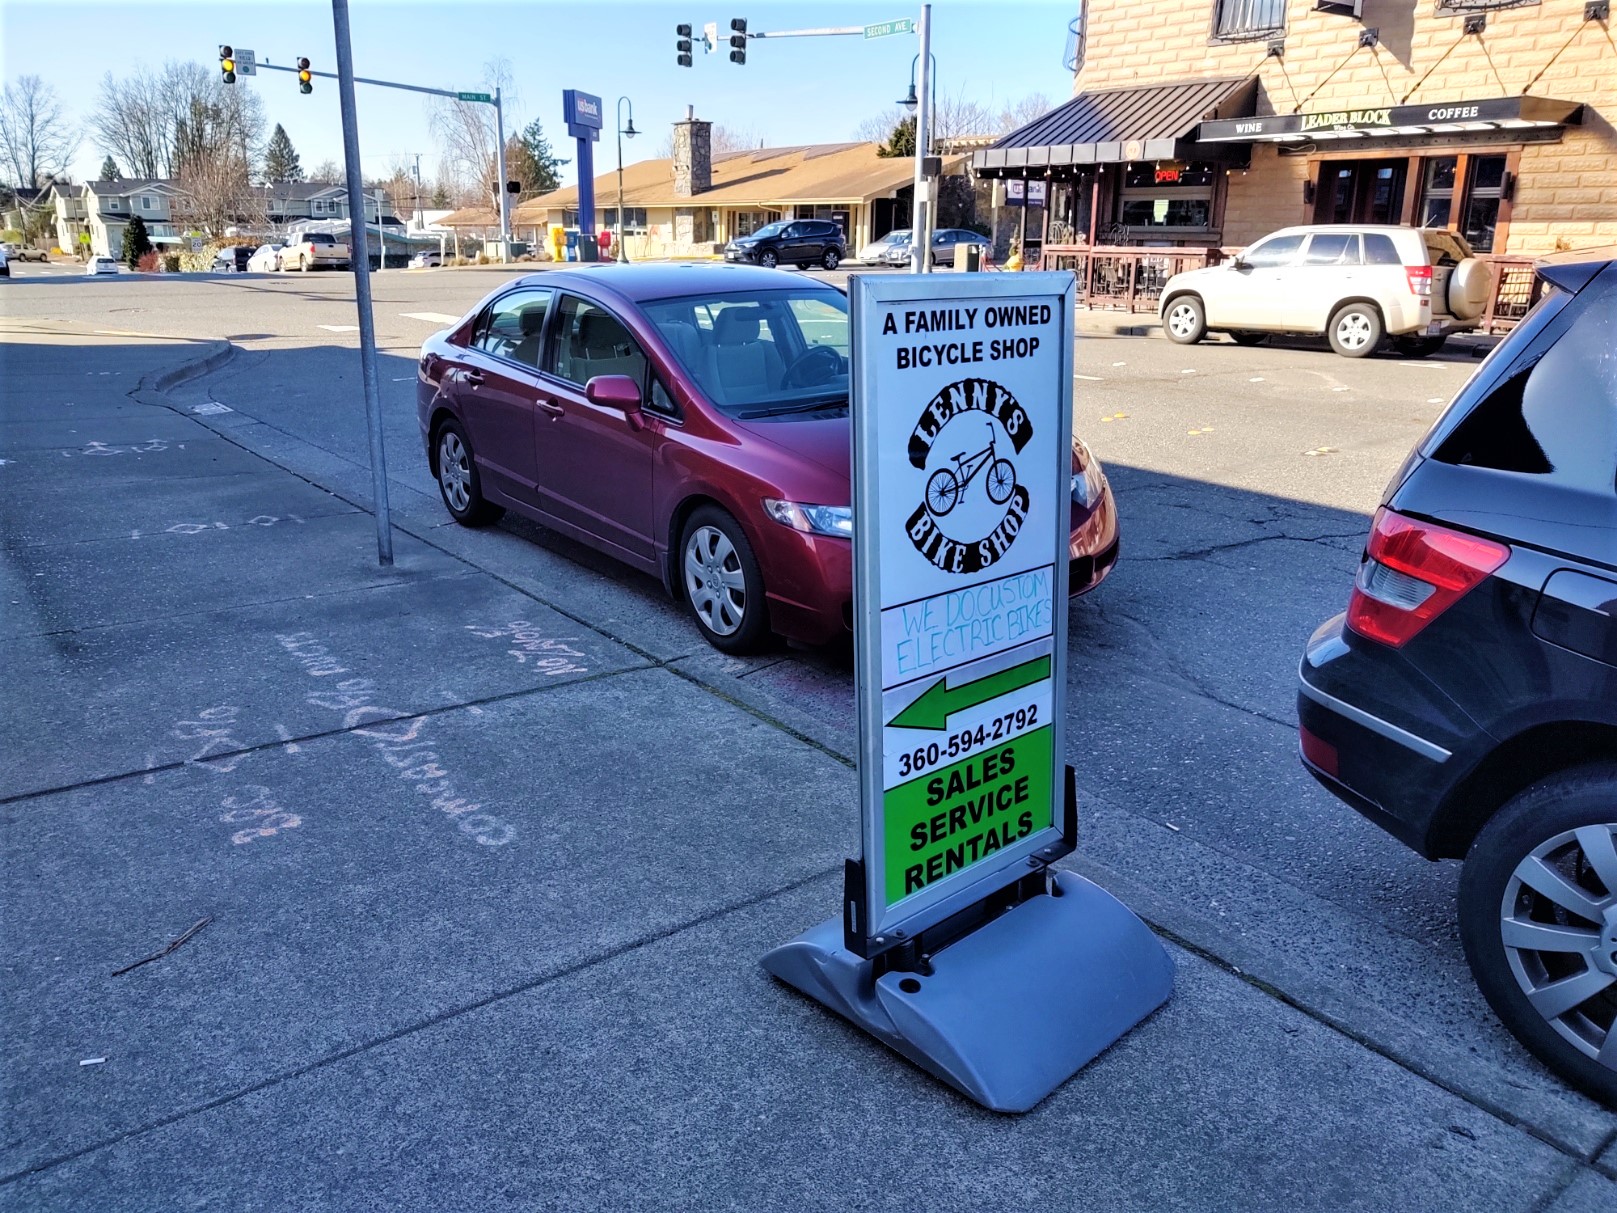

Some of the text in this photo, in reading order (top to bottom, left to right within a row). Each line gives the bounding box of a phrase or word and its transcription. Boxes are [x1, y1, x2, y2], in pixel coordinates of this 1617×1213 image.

[866, 24, 890, 37] SECOND
[1236, 122, 1262, 134] WINE
[1301, 109, 1392, 131] LEADER BLOCK
[1428, 106, 1479, 120] COFFEE
[1155, 170, 1178, 182] OPEN
[882, 304, 1051, 336] A FAMILY OWNED
[897, 336, 1040, 370] BICYCLE SHOP
[914, 382, 1024, 448] LENNY'S
[910, 495, 1027, 573] BIKE SHOP
[897, 598, 1052, 675] ELECTRIC BIKES
[902, 598, 938, 637] WE
[898, 703, 1038, 777] 360-594-2792
[926, 747, 1016, 807] SALES
[909, 774, 1029, 852] SERVICE
[904, 810, 1034, 896] RENTALS
